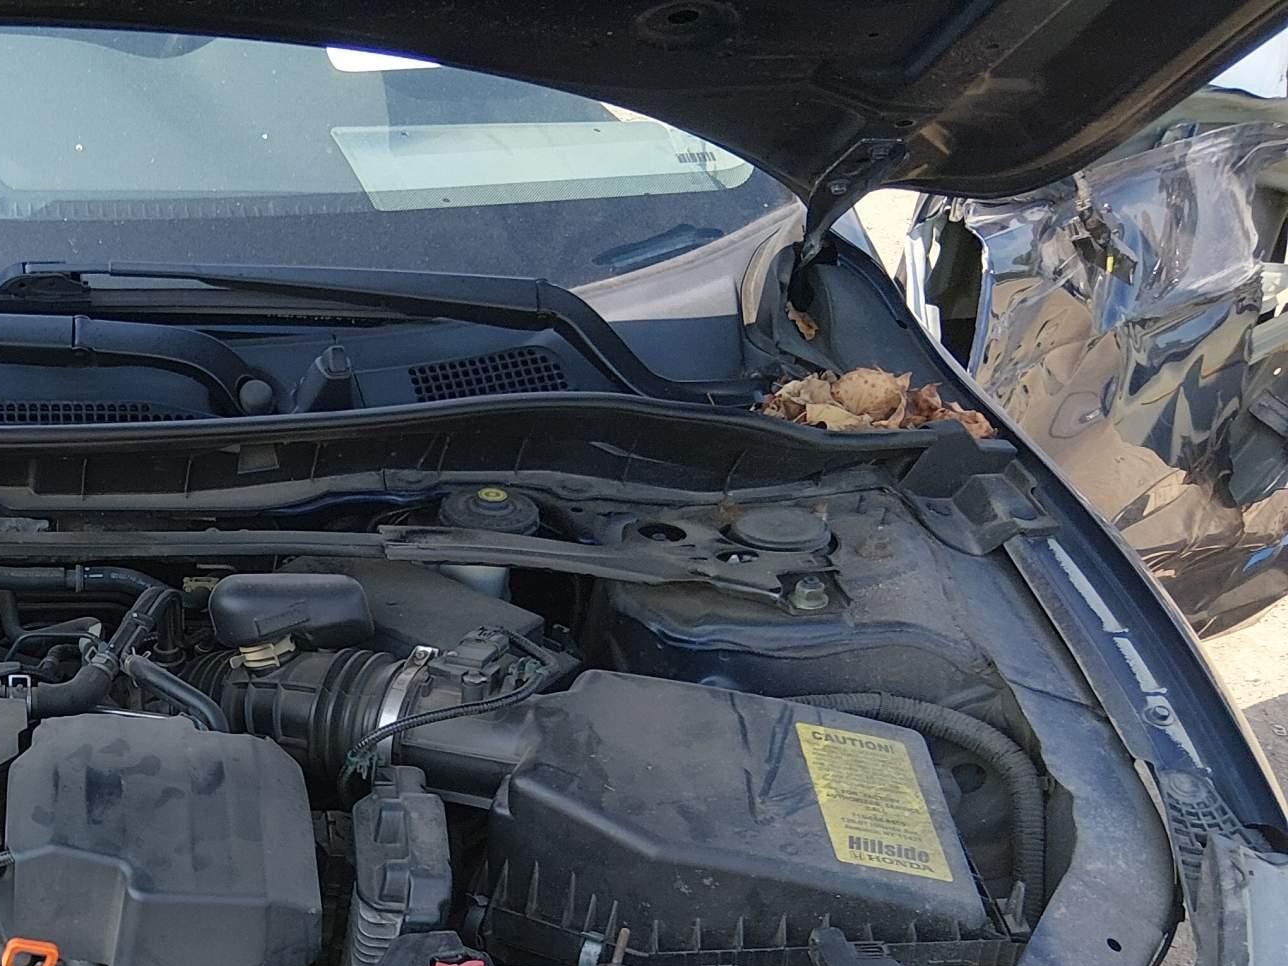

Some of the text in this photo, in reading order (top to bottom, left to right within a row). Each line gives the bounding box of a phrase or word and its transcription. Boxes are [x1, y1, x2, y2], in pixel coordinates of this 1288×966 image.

[811, 731, 896, 755] CAUTION!
[848, 835, 930, 864] Hillside
[868, 855, 936, 873] HONDA
